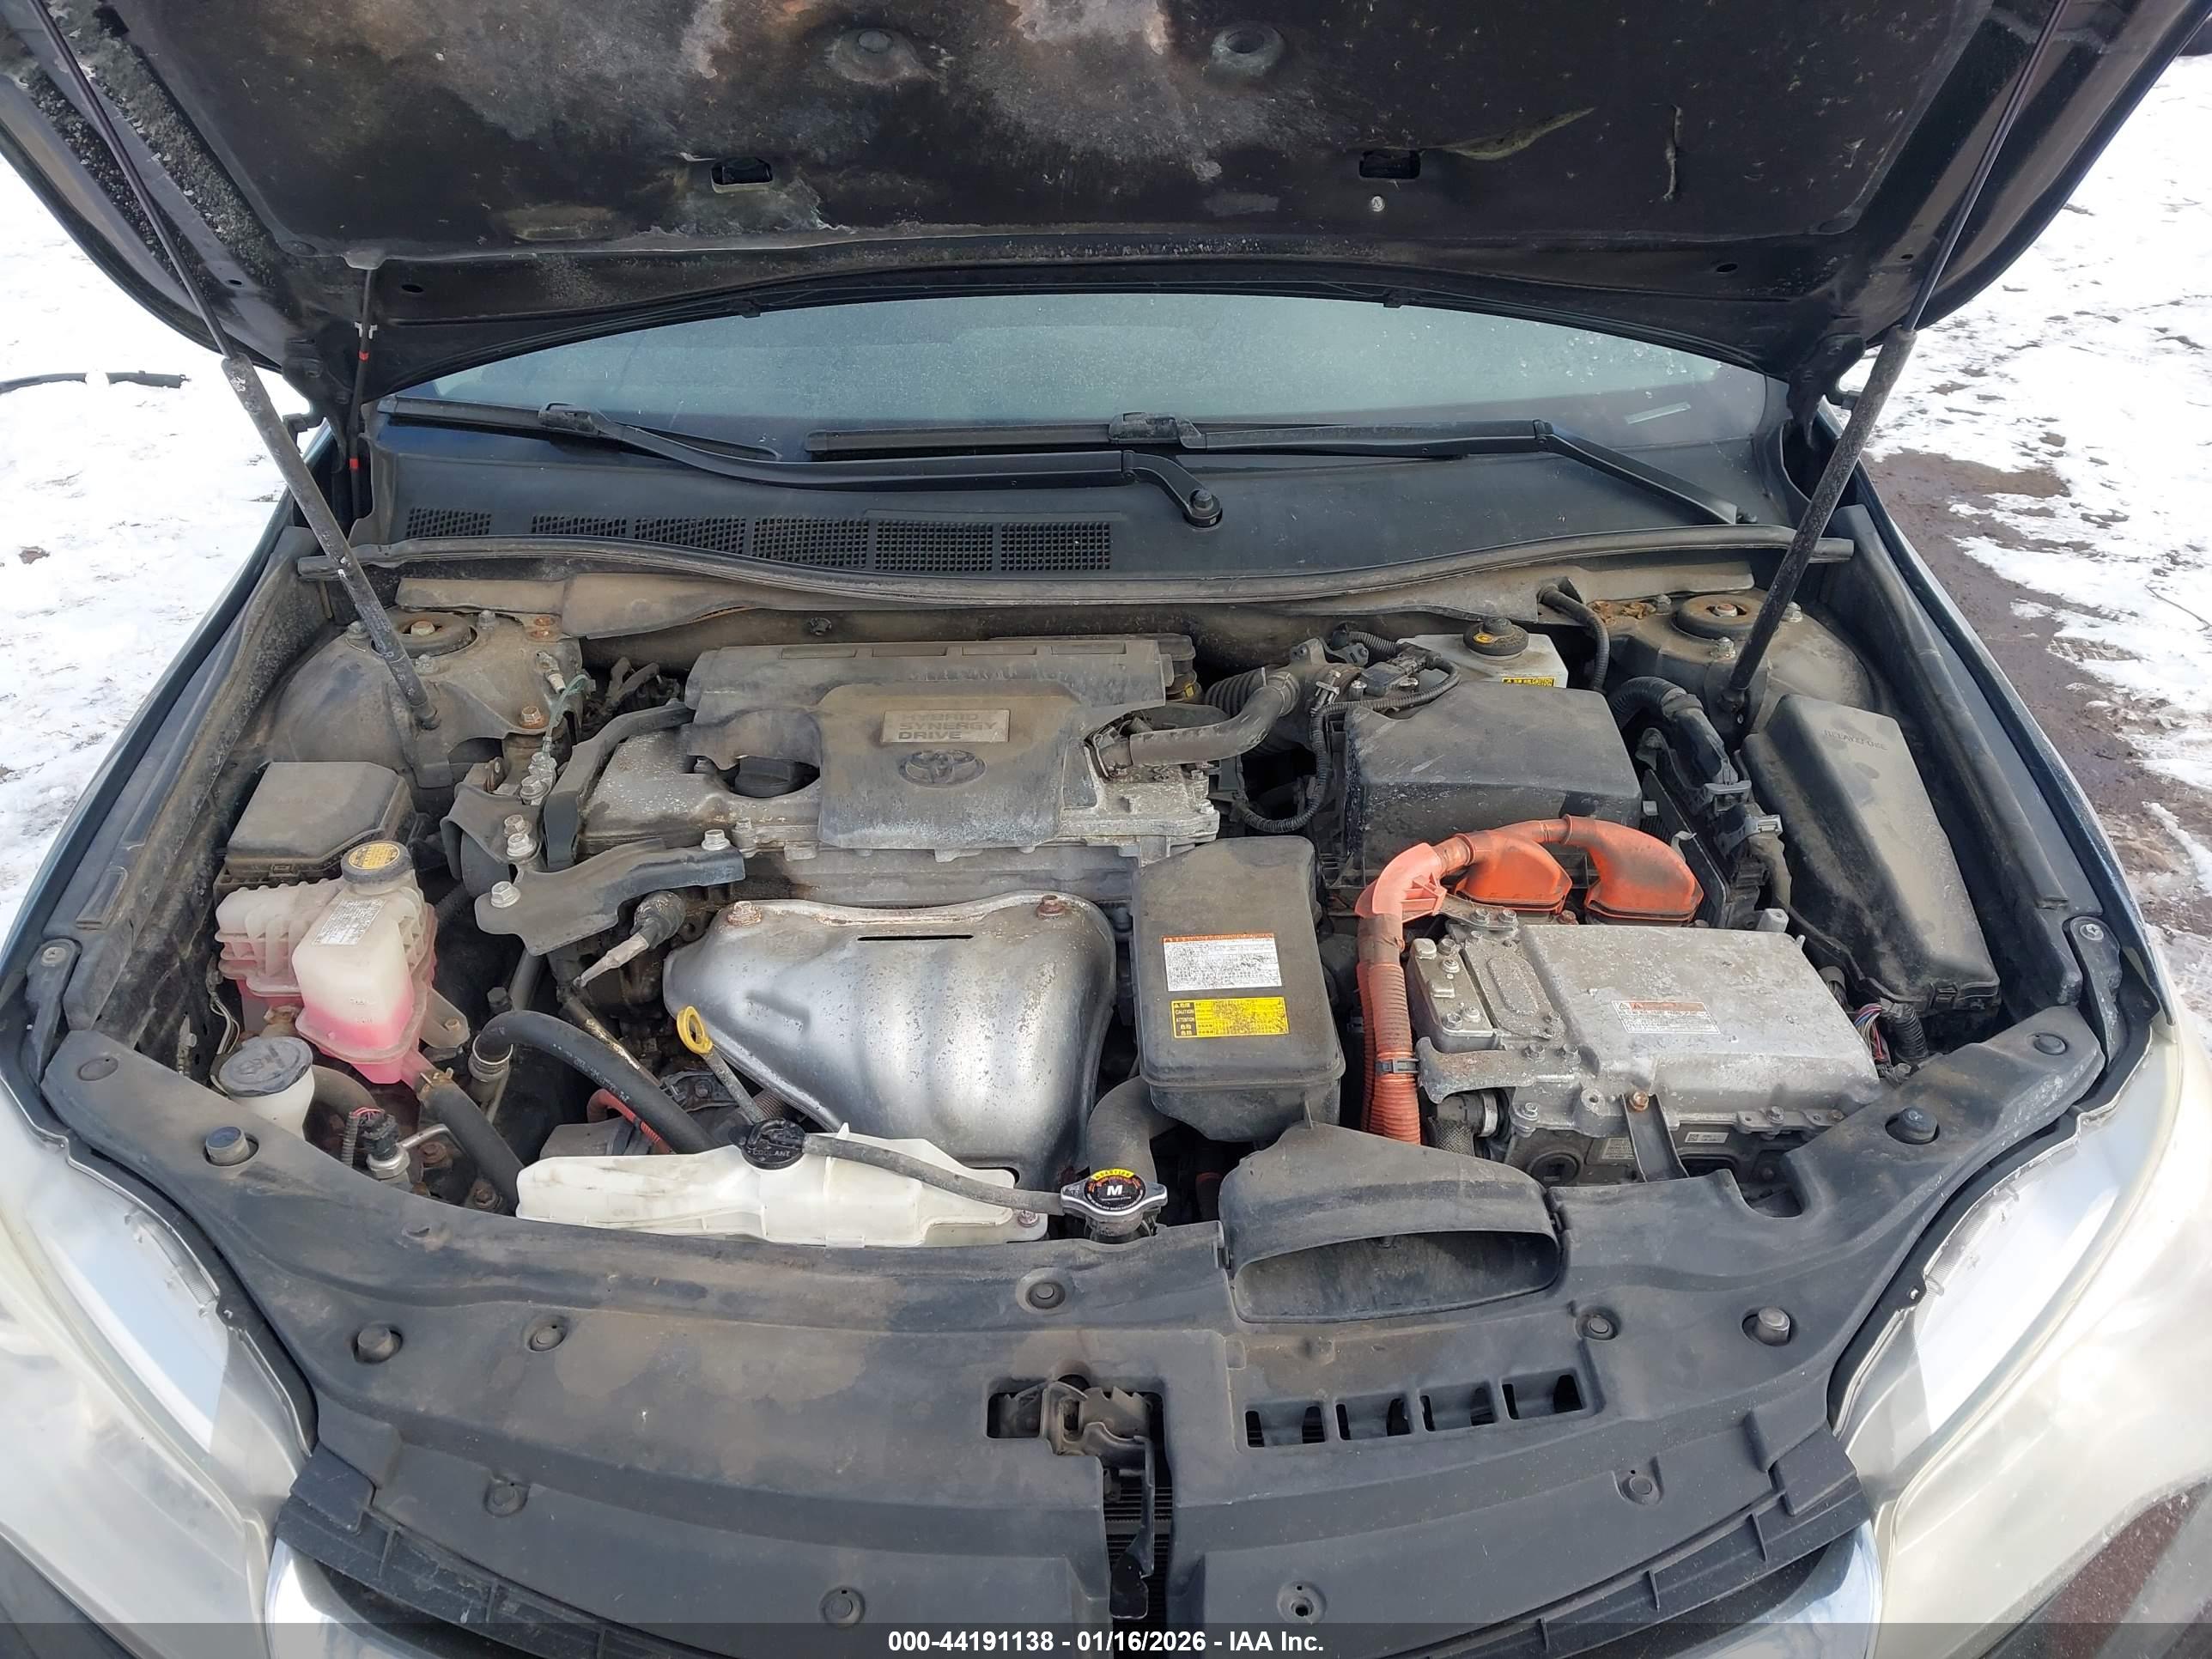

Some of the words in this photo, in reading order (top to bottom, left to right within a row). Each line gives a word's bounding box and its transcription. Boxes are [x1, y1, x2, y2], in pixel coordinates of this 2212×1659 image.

[898, 731, 963, 739] DRIVE
[752, 1149, 791, 1158] COOLANT
[1107, 1184, 1123, 1196] M
